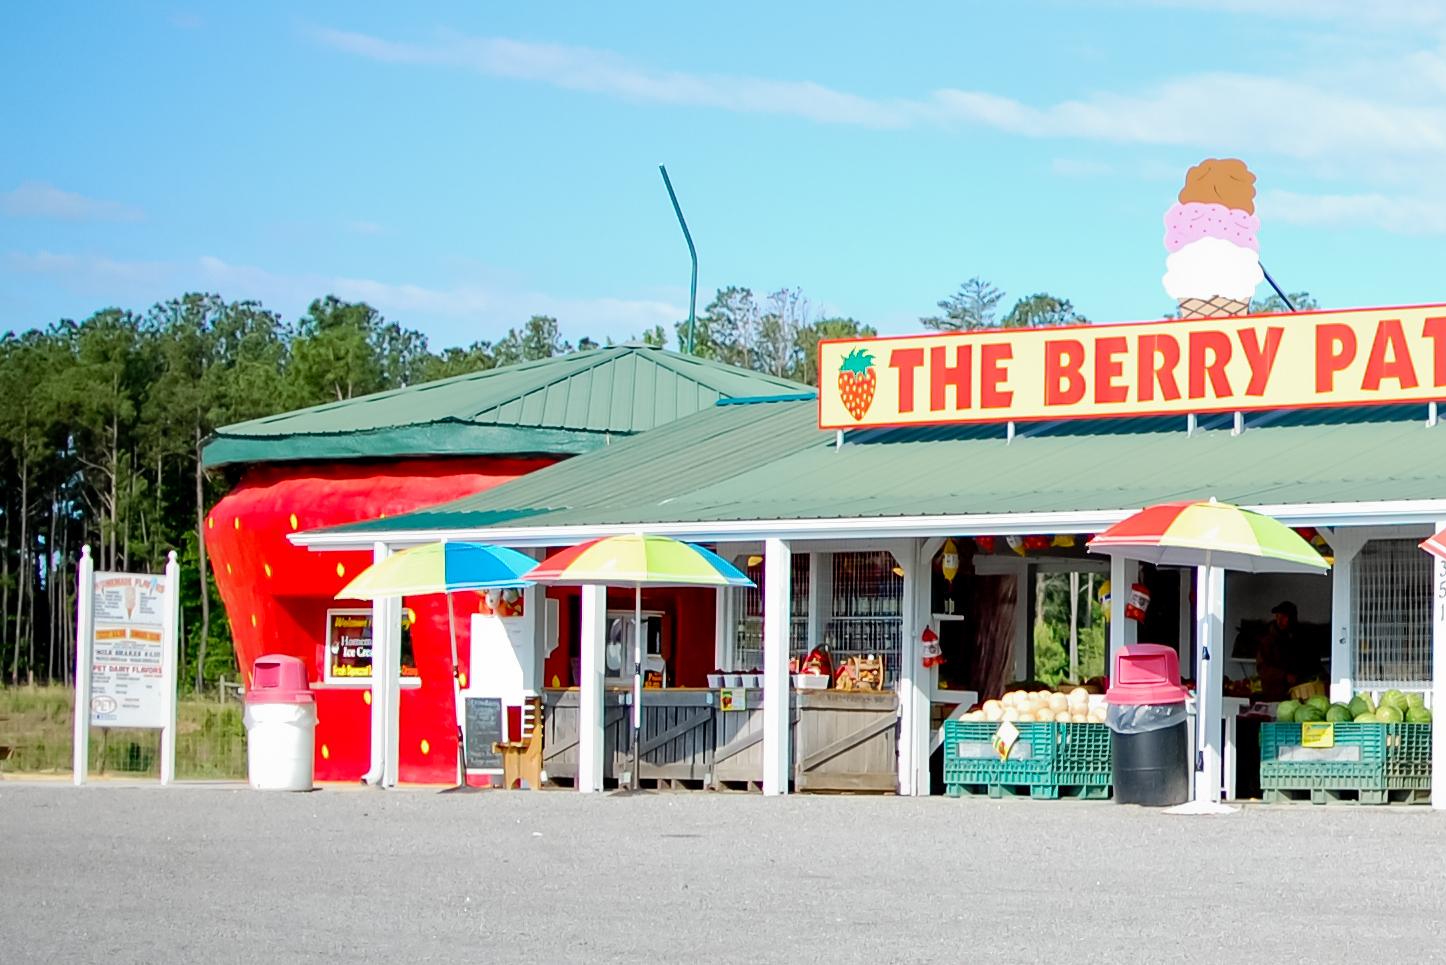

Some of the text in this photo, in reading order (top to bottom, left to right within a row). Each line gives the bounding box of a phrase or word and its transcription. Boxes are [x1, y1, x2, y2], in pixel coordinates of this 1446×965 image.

[889, 342, 1014, 414] THE
[1044, 326, 1285, 407] BERRY
[357, 647, 373, 658] Cre
